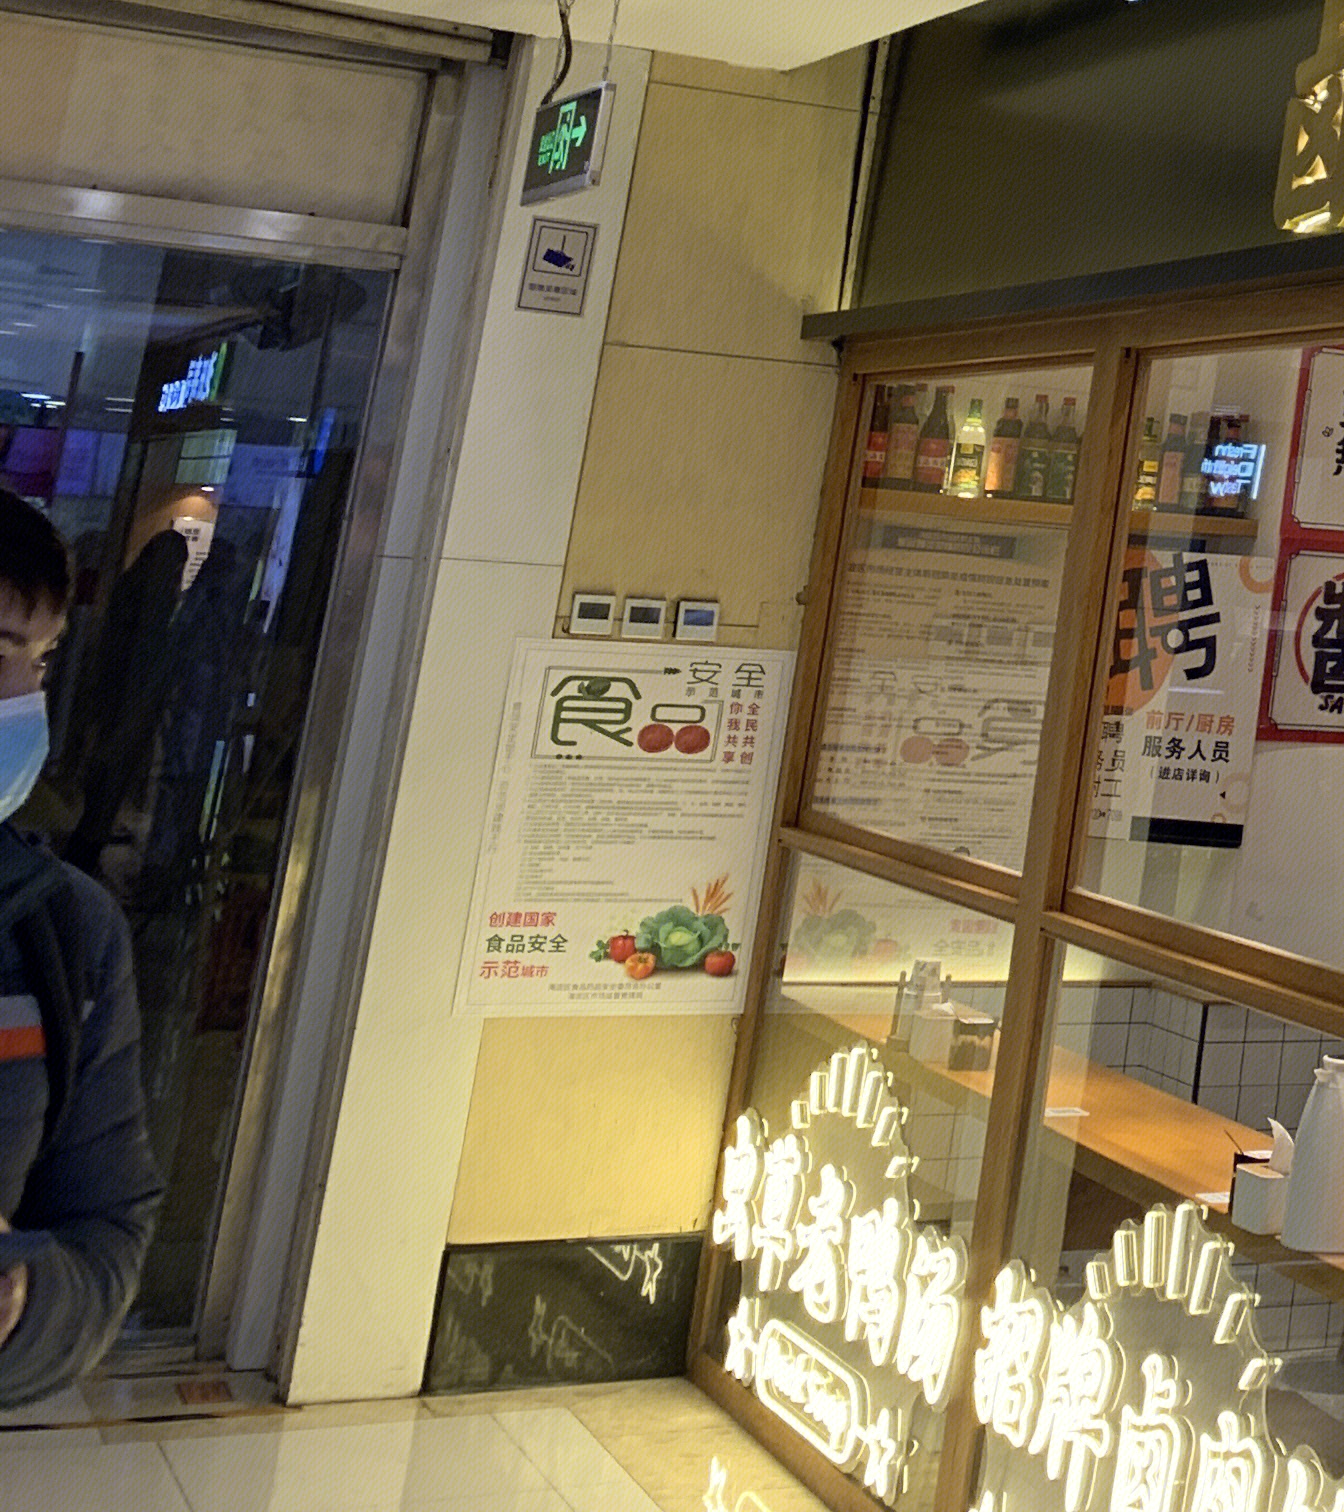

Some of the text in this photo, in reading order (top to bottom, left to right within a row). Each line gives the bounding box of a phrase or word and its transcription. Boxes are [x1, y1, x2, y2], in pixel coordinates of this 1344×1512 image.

[686, 659, 767, 688] 安全
[721, 701, 744, 765] 你我共享
[739, 701, 762, 766] 全民共创
[1145, 709, 1237, 737] 前厅/厨房
[1141, 734, 1231, 764] 服务人员
[488, 910, 558, 929] 创建国家
[485, 933, 569, 955] 食品安全
[478, 959, 550, 980] 示范城市
